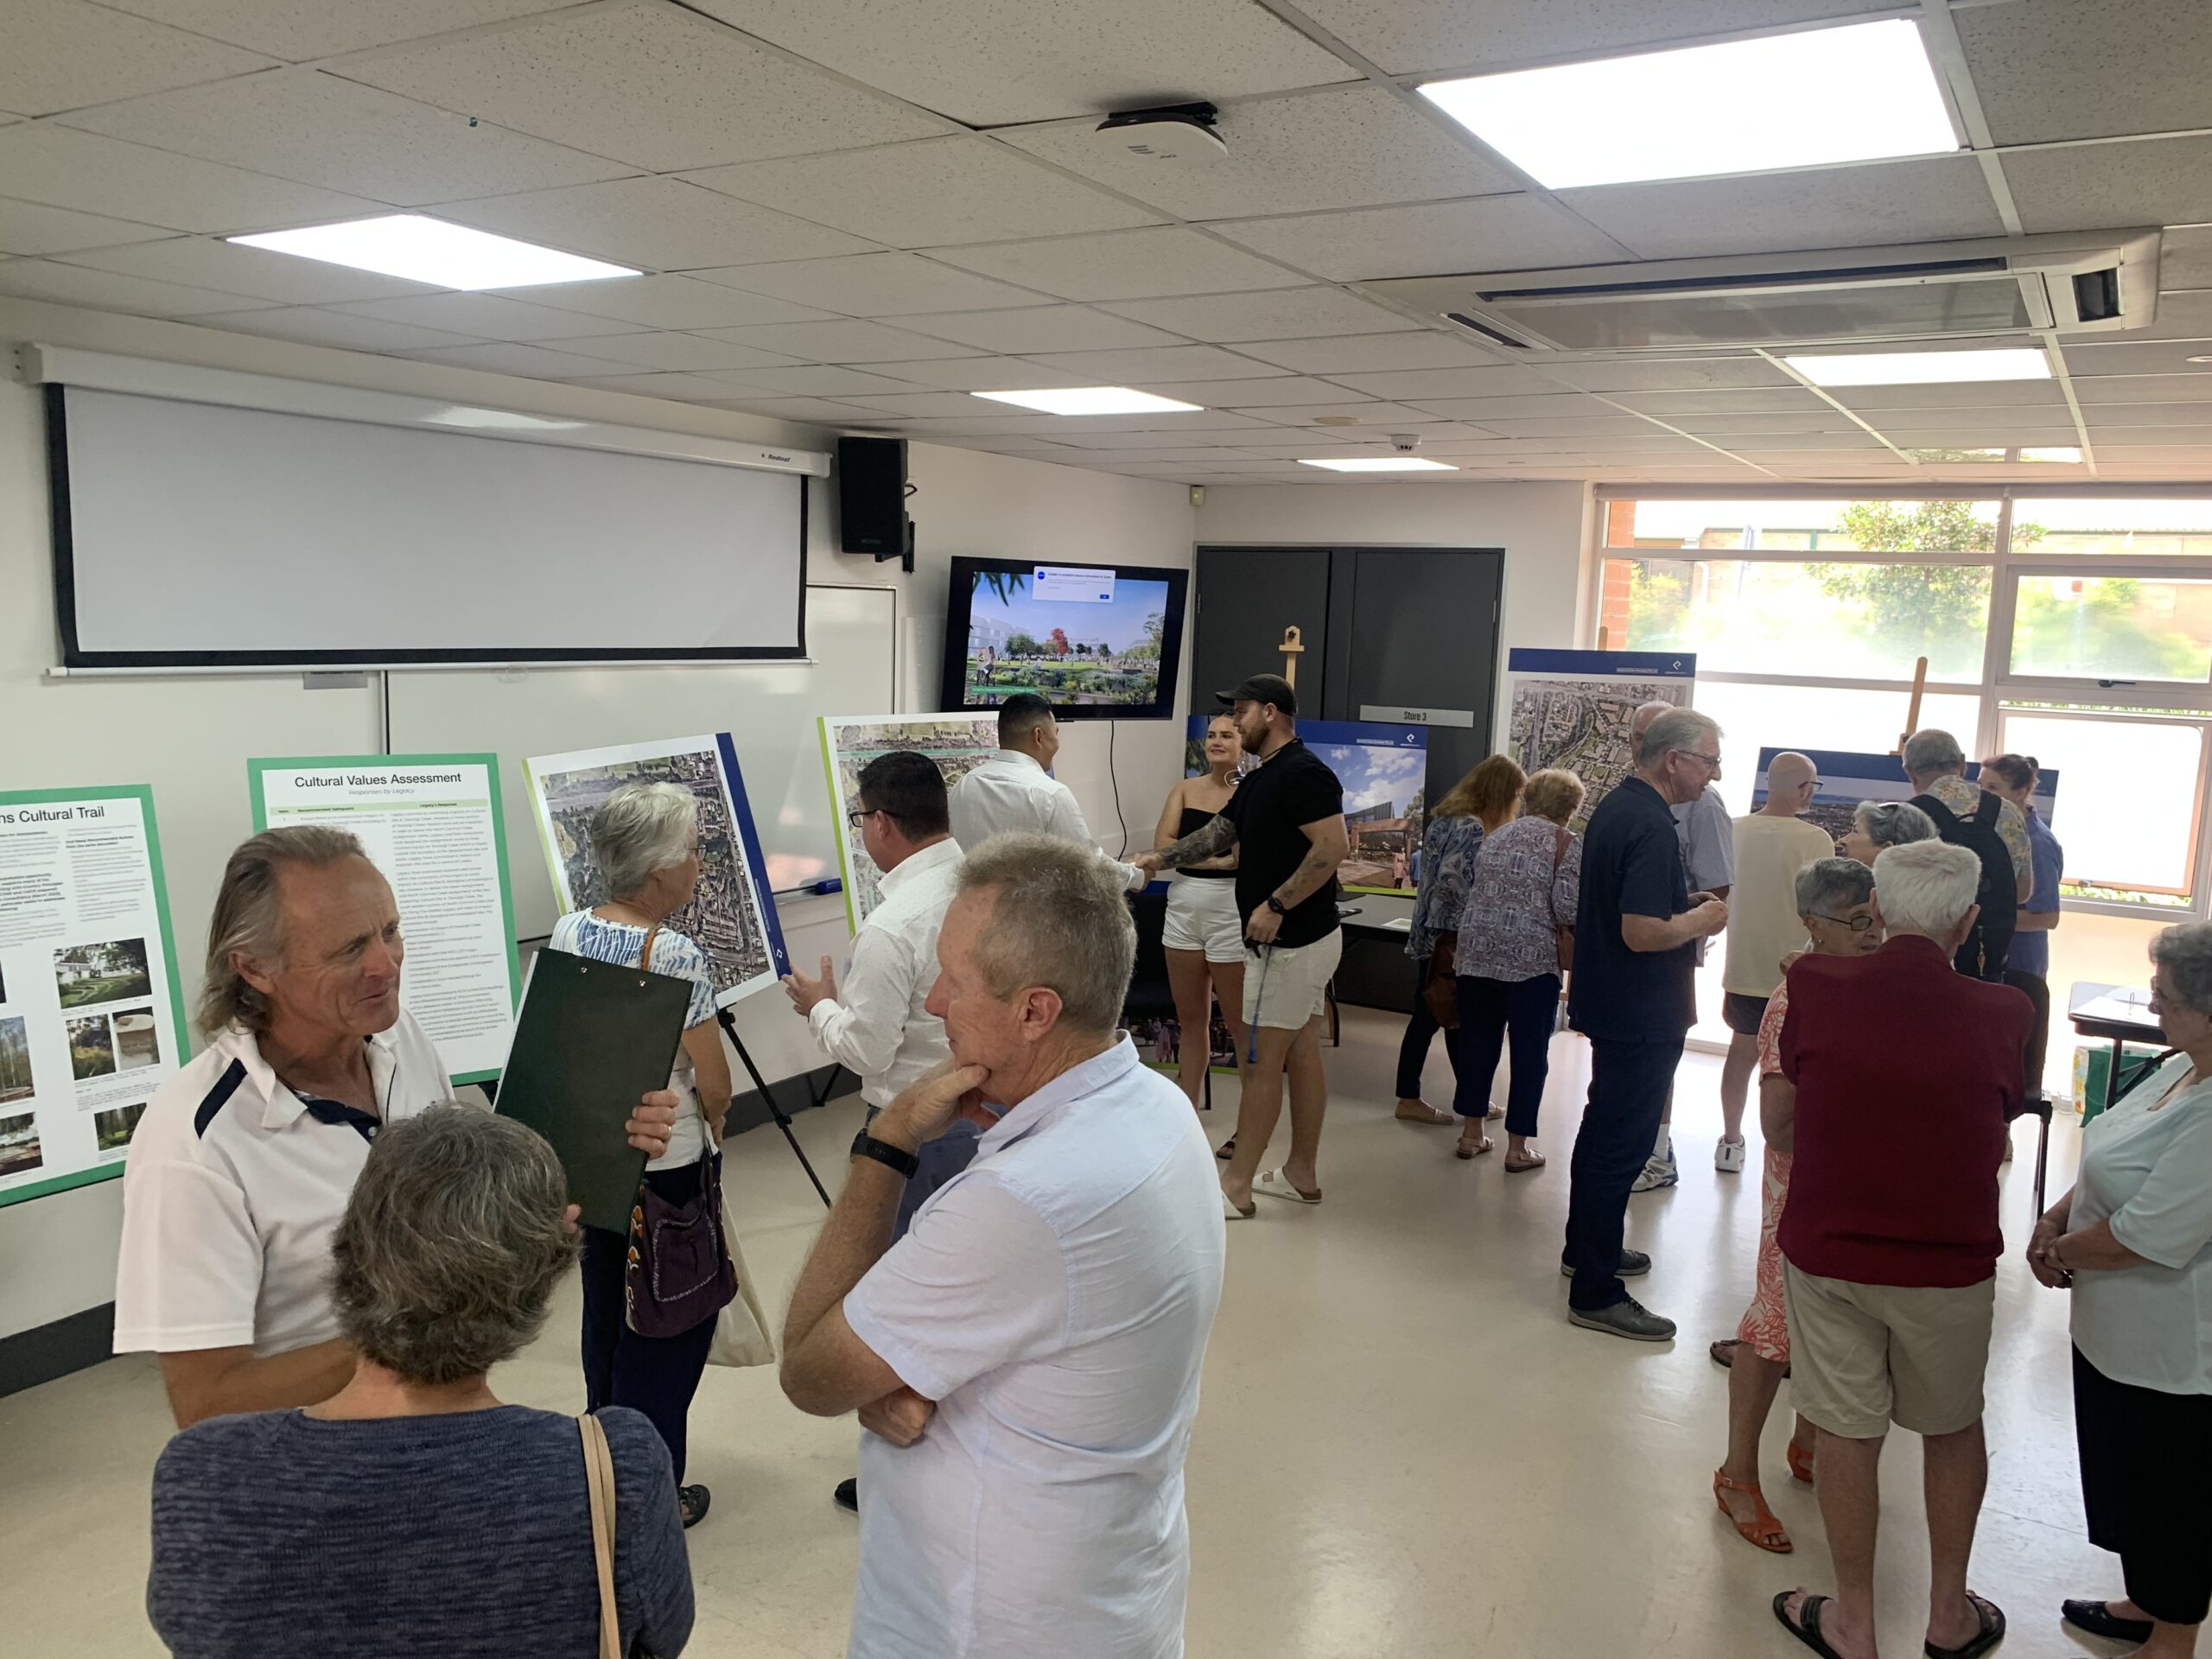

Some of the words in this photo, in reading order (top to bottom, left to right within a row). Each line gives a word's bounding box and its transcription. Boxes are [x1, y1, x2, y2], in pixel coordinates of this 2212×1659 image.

[1403, 710, 1421, 721] Store
[1421, 712, 1427, 721] 3
[295, 775, 344, 788] Cultural
[346, 774, 387, 785] Values
[391, 772, 461, 785] Assessment
[19, 808, 73, 823] Cultural
[76, 805, 105, 818] Trail
